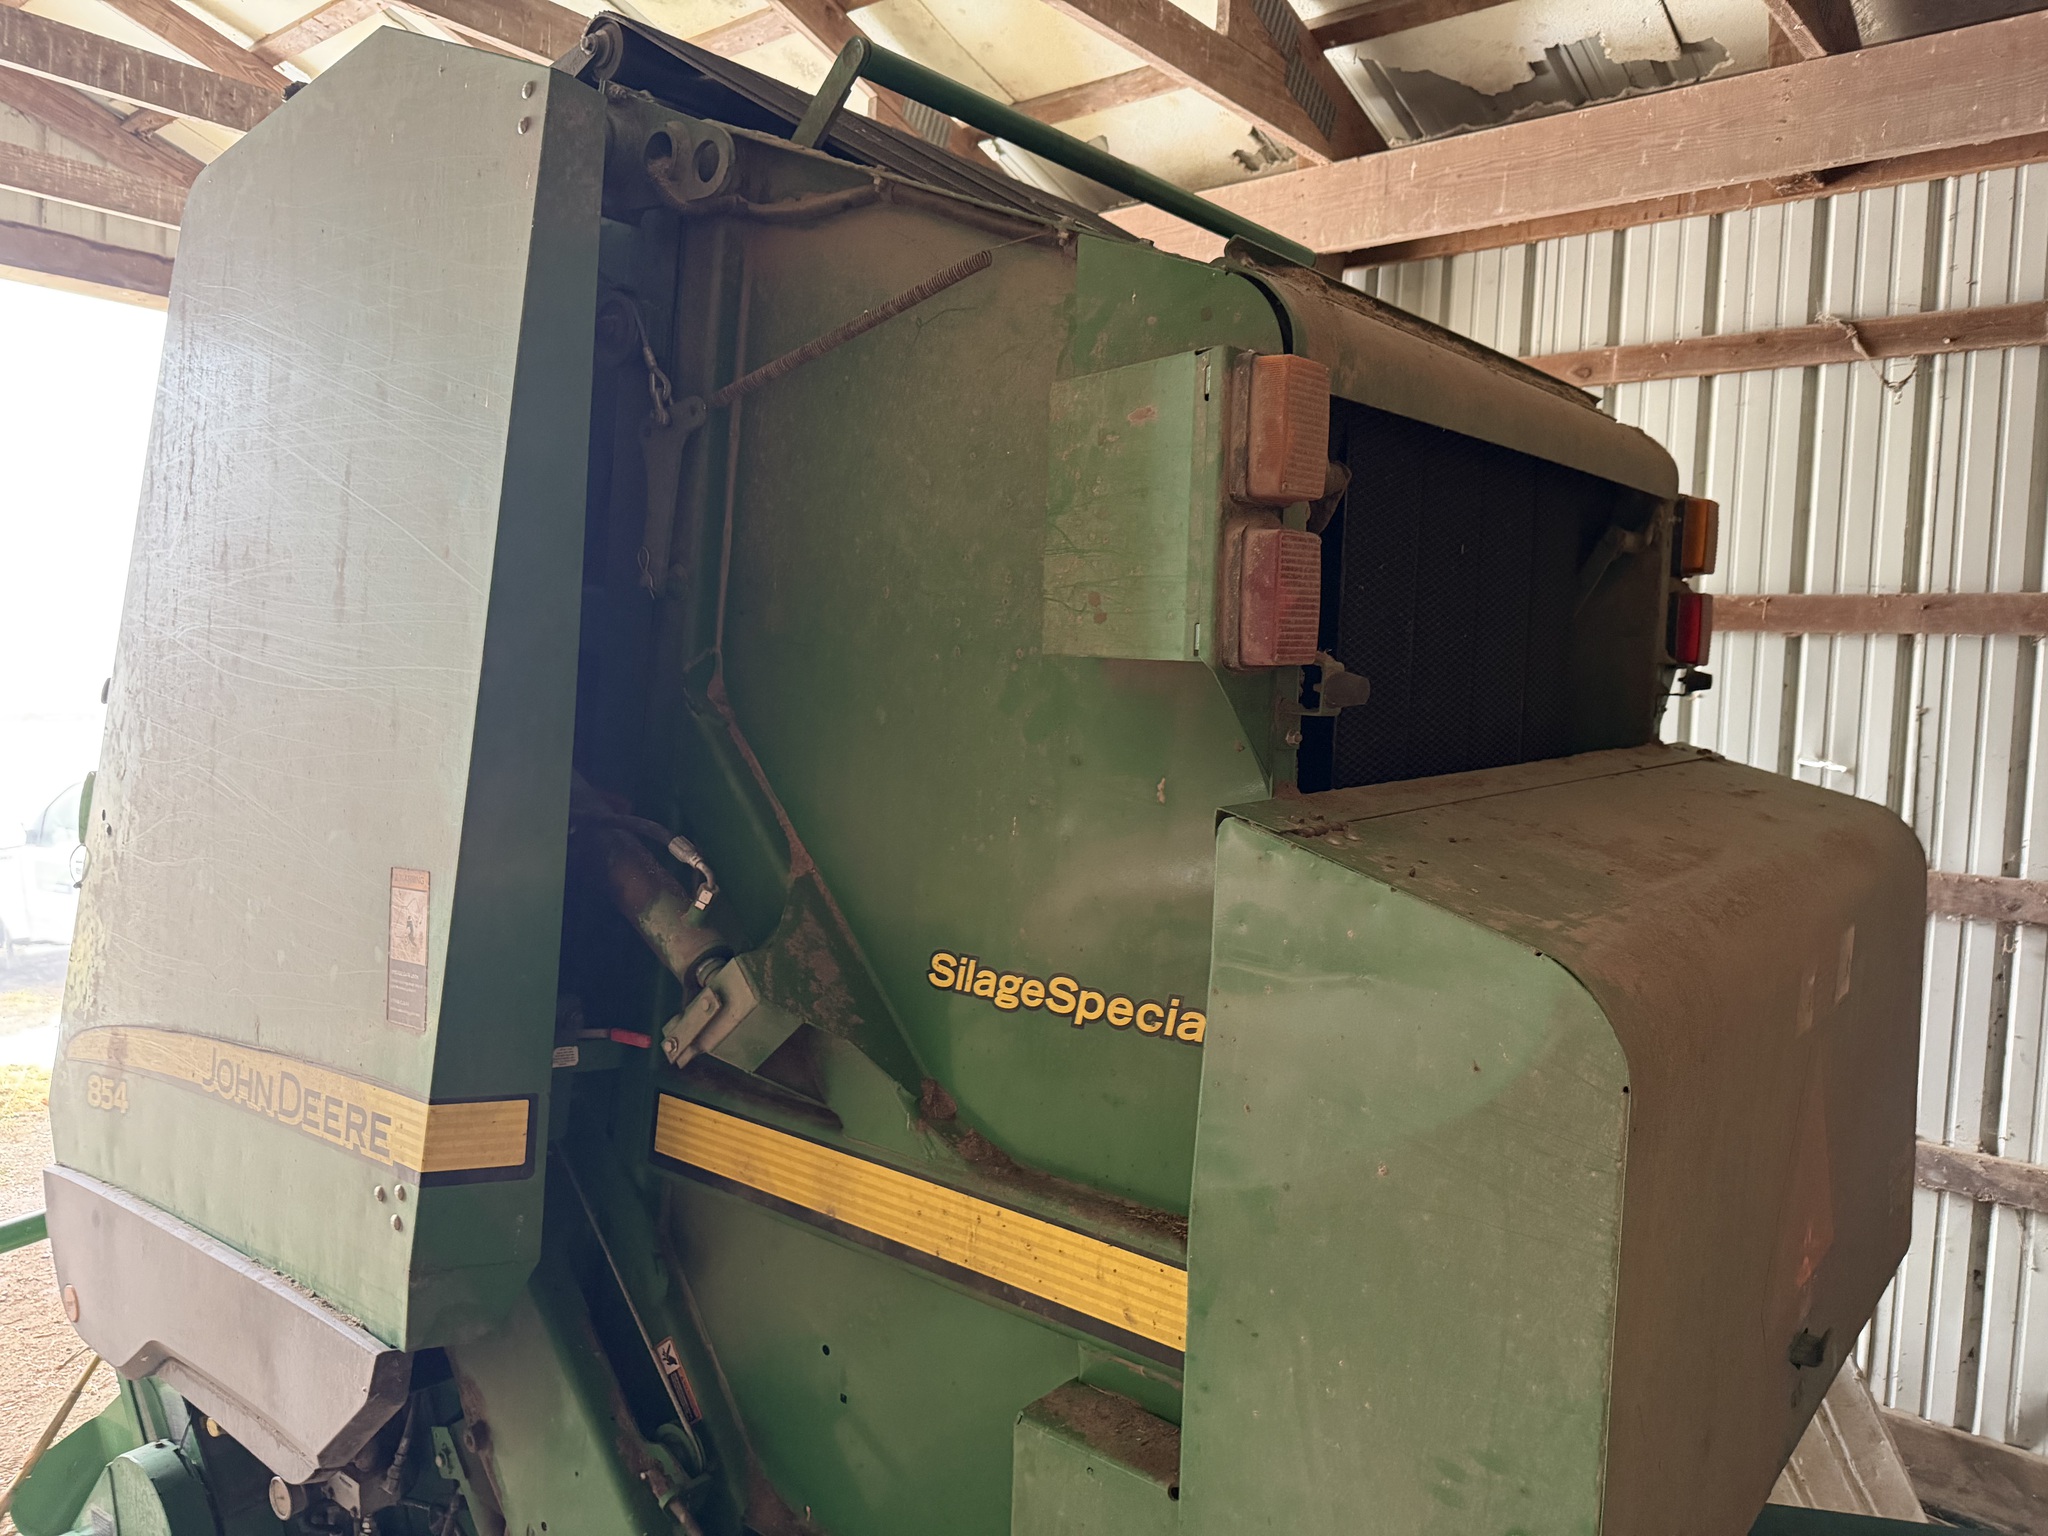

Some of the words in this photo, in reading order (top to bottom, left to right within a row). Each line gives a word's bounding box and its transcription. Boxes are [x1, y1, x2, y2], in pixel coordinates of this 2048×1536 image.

[87, 1075, 128, 1114] 854
[201, 1047, 273, 1115] JOHN
[277, 1069, 392, 1162] DEERE
